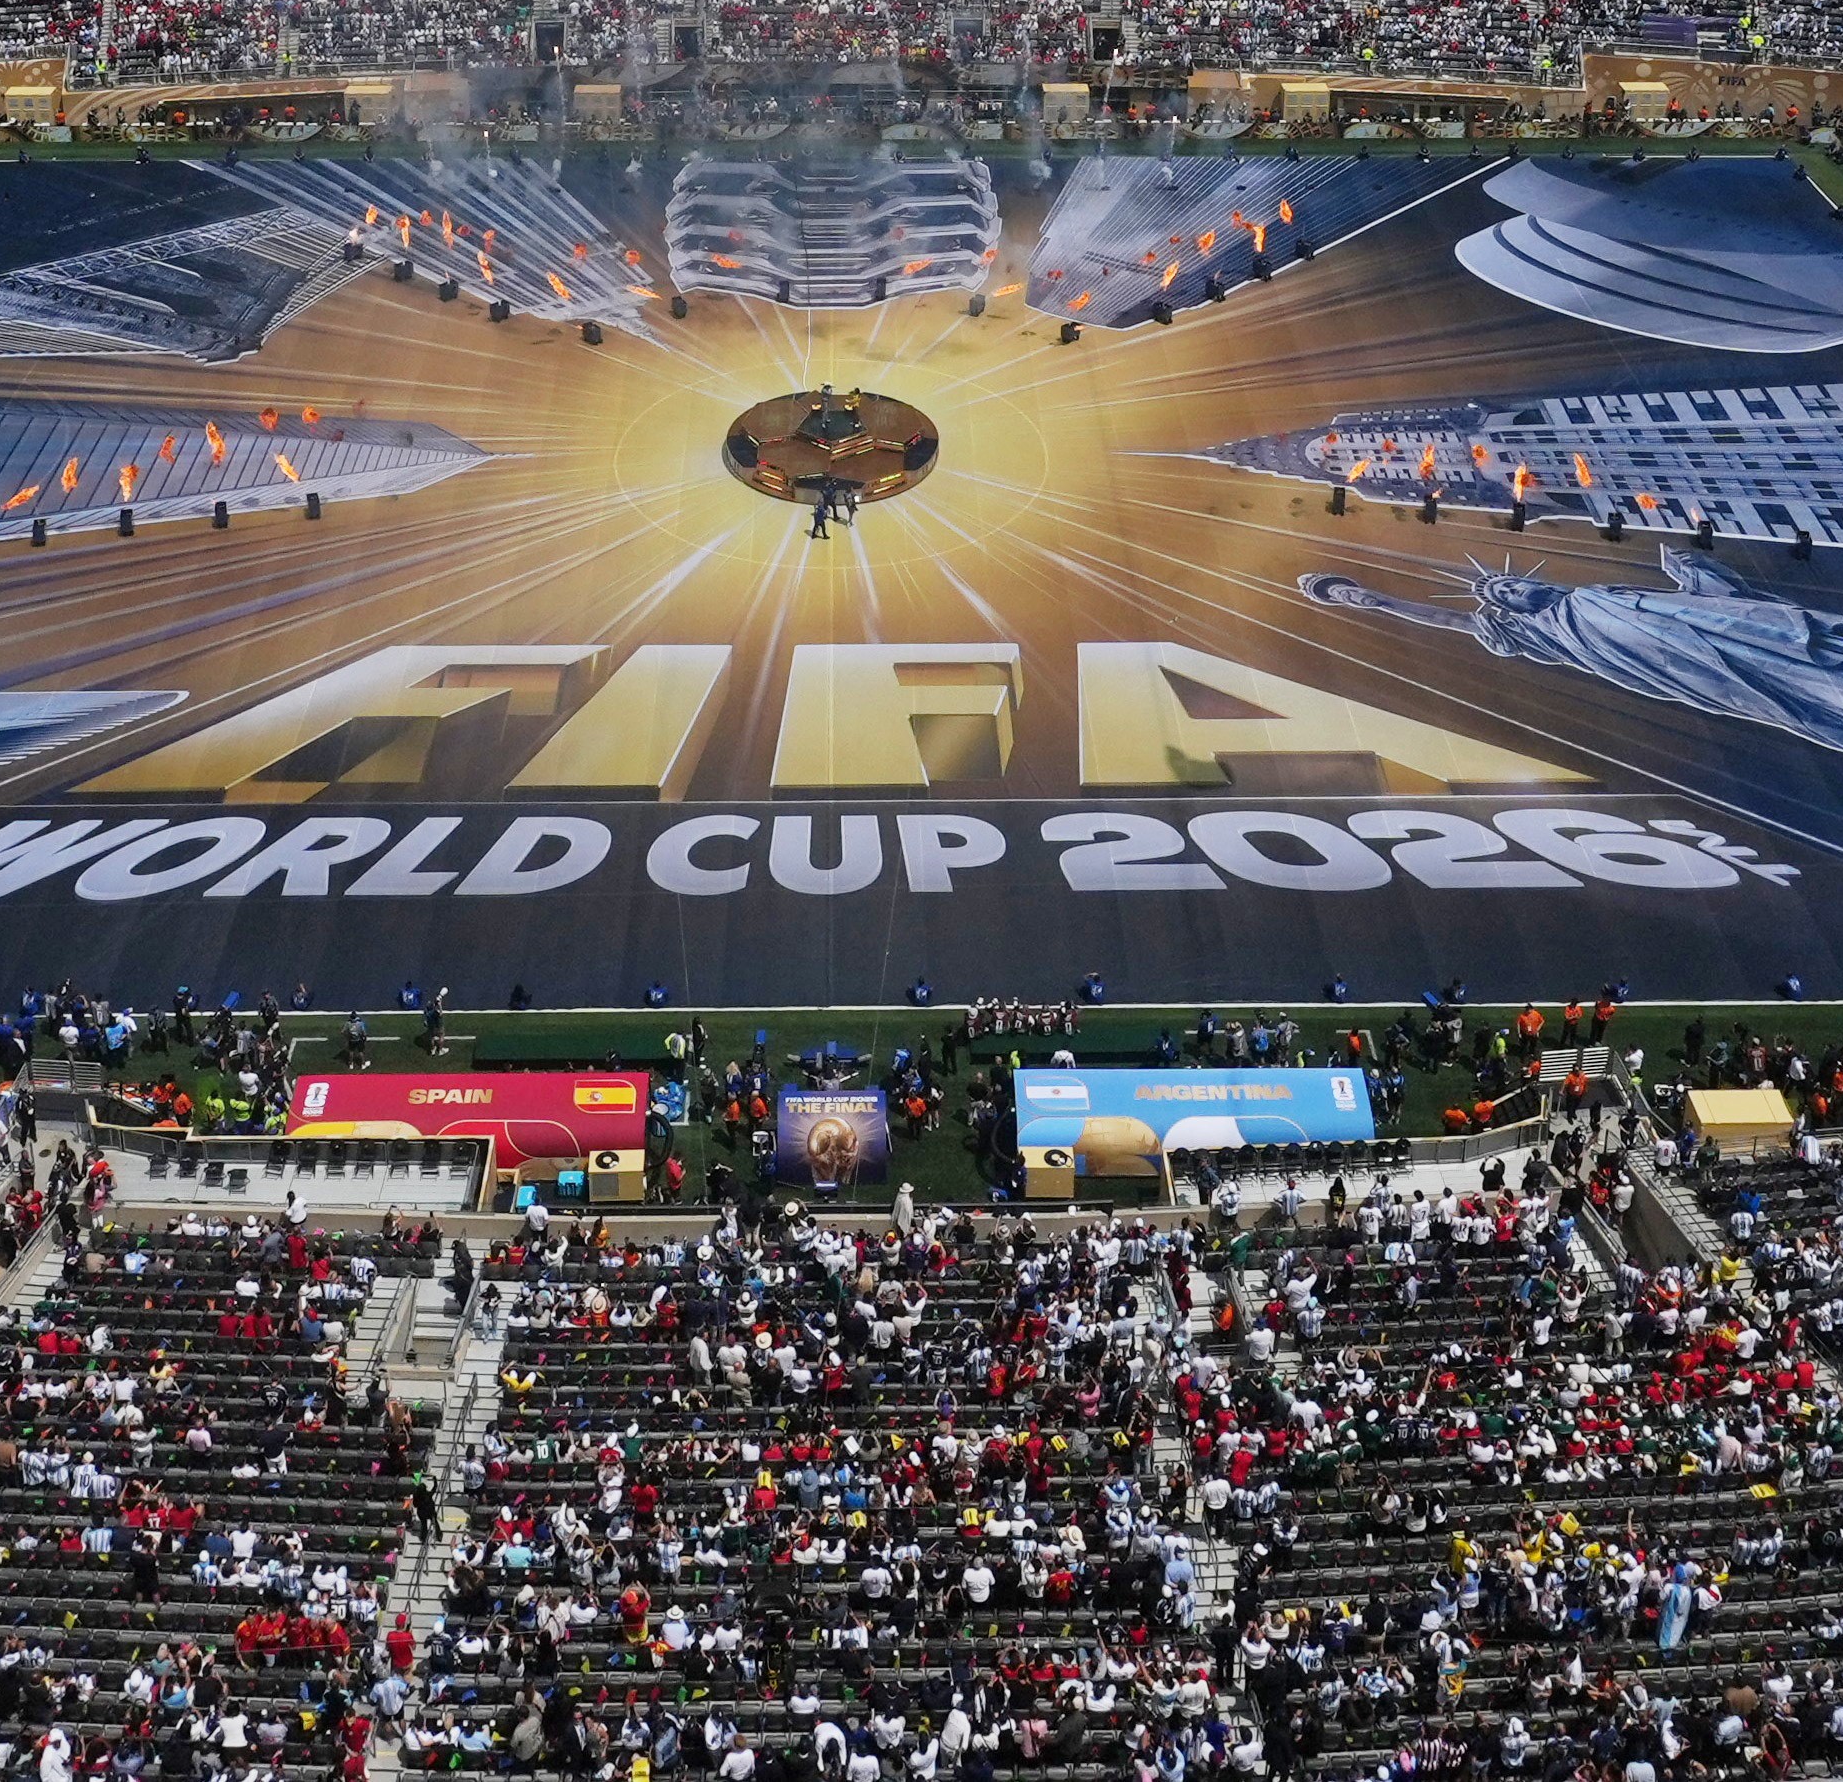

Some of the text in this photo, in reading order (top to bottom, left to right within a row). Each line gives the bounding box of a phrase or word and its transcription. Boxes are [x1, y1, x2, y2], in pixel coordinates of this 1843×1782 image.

[1718, 76, 1748, 88] FIFA
[65, 642, 1603, 800] FIFA
[646, 813, 1007, 896] CUP
[407, 1088, 494, 1105] SPAIN
[1134, 1084, 1294, 1101] ARGENTINA
[786, 1102, 878, 1114] THE FINAL
[536, 1443, 549, 1459] 10
[147, 1517, 161, 1528] 17
